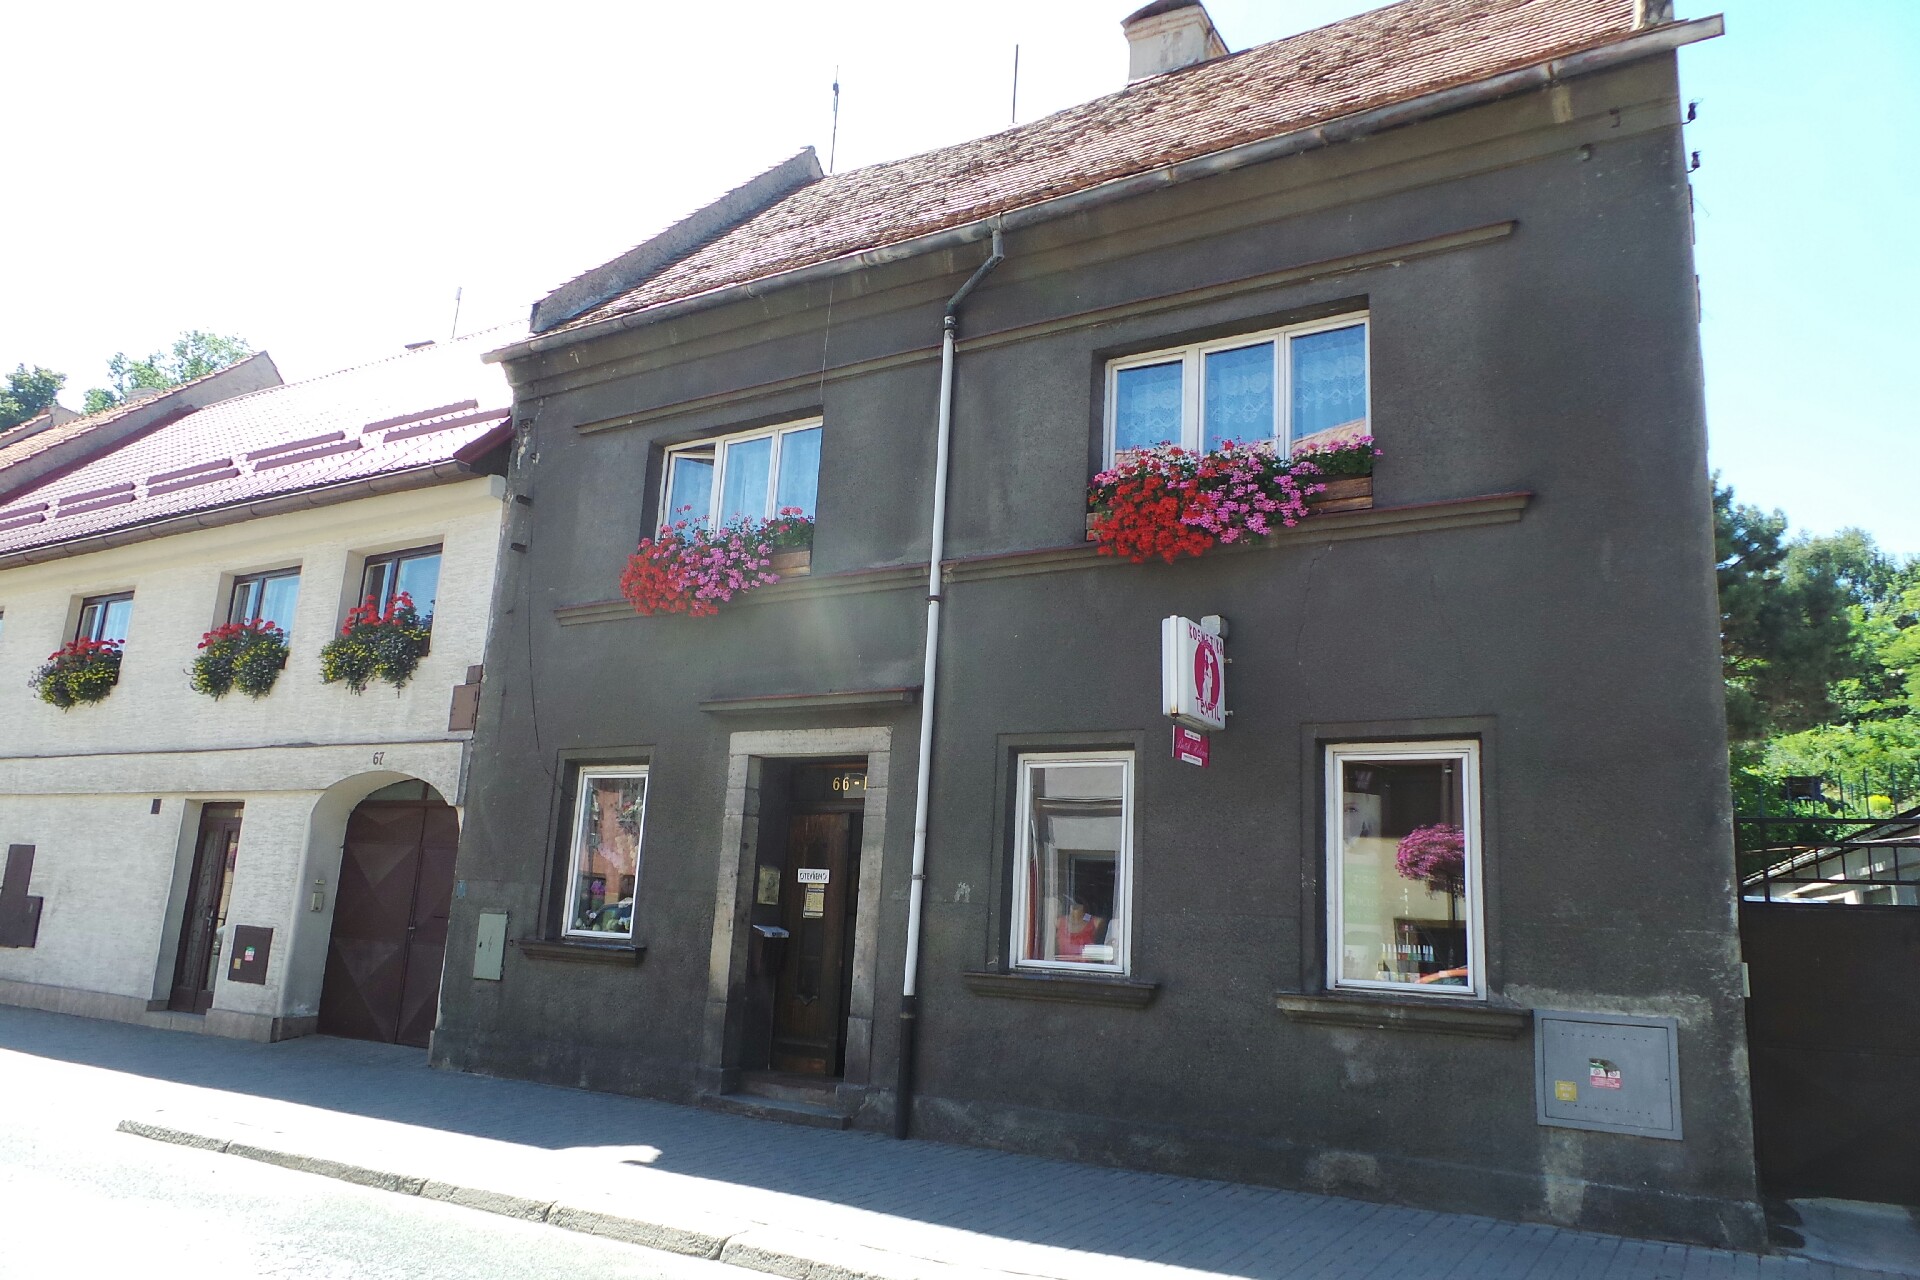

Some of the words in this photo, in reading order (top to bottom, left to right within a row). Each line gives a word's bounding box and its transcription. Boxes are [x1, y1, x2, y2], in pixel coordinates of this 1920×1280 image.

[1188, 622, 1224, 656] KOSMETIKA
[1195, 696, 1221, 722] TEXTIL
[372, 751, 386, 766] 67
[799, 871, 828, 880] OTEVŘENO
